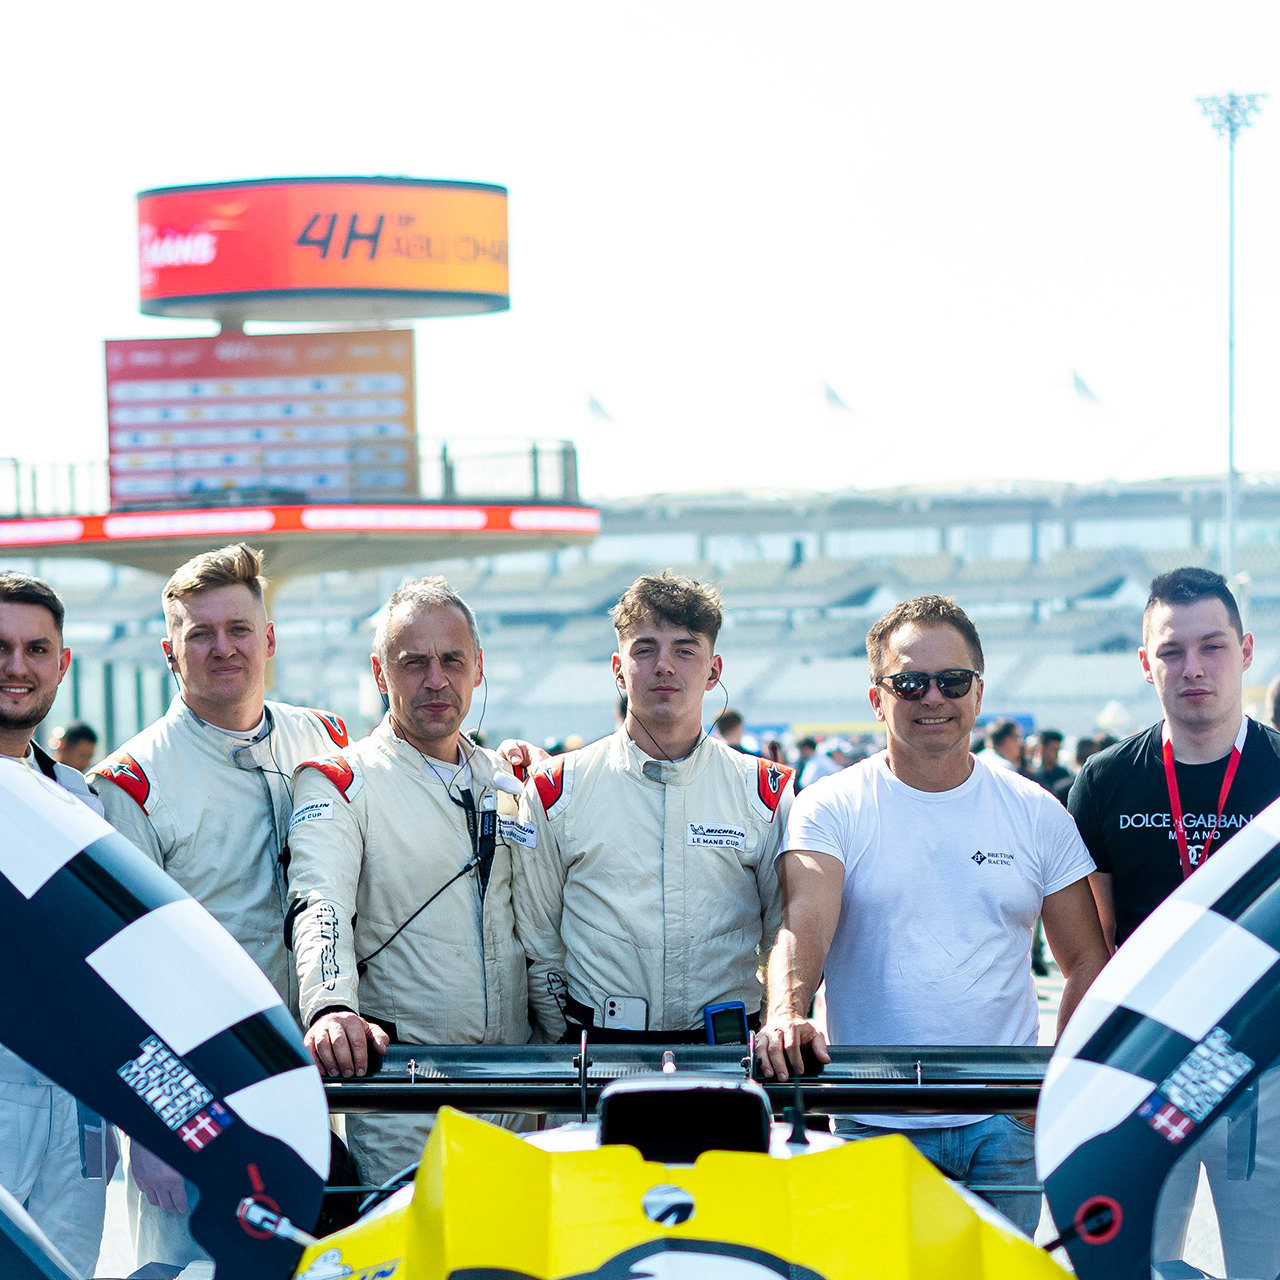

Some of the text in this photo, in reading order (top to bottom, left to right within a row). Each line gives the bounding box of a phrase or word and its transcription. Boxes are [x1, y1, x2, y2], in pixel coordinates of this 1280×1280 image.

[293, 212, 384, 259] 4H
[1120, 813, 1171, 829] DOLCE
[1182, 813, 1253, 829] GABBAN
[705, 828, 745, 838] MICHELIN
[1168, 830, 1221, 840] MLANO
[725, 839, 740, 847] CUP
[142, 1037, 210, 1105] PEEBLES
[135, 1060, 197, 1116] JENSEN
